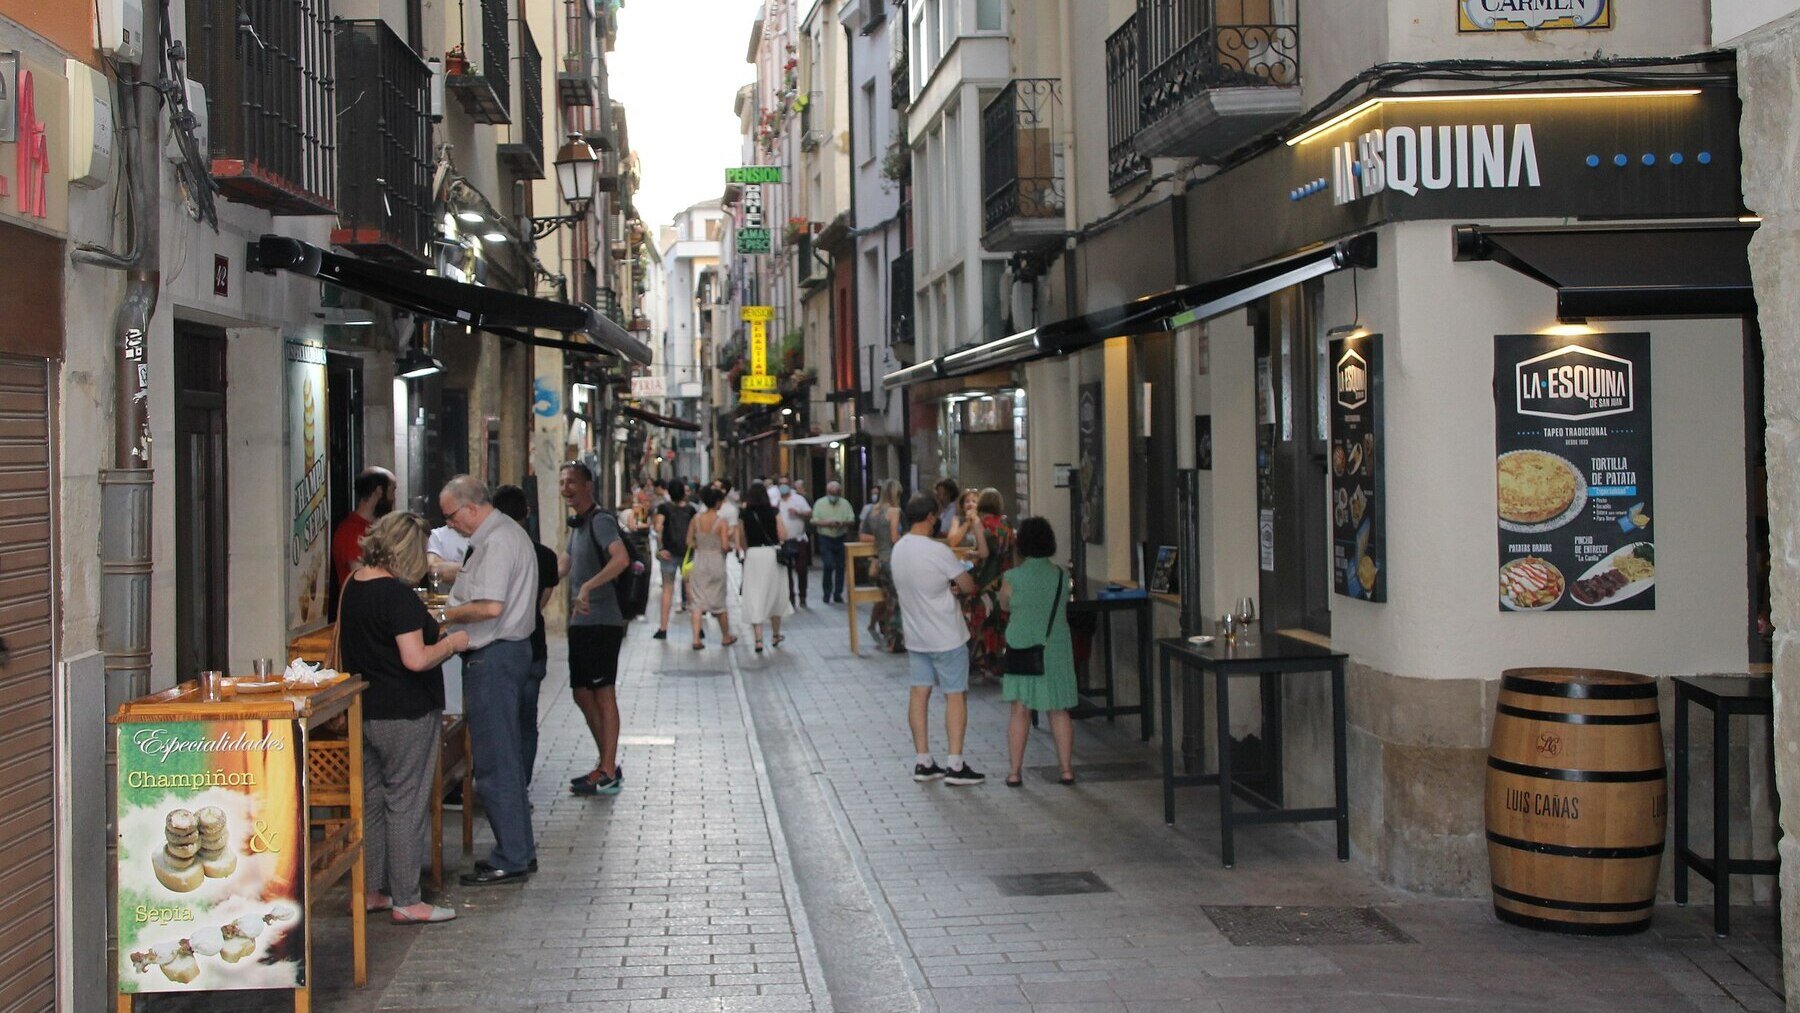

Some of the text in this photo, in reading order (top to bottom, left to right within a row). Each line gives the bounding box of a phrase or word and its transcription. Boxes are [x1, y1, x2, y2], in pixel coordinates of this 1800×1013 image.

[1358, 123, 1541, 197] ESQUINA
[727, 167, 781, 183] PENSION
[1523, 365, 1626, 401] LA ESQUINA
[1589, 397, 1623, 409] DE SAN JUAN
[1543, 427, 1608, 438] TAPEO TRADICIONAL
[1591, 456, 1628, 471] TORTILLA
[1592, 471, 1636, 486] DE PATATA
[1508, 544, 1552, 553] PATATAS BRAVAS
[1575, 545, 1582, 554] DE
[133, 729, 285, 763] Especialidades
[128, 768, 257, 790] Champiñon
[1506, 788, 1579, 820] LUIS CAÑAS
[249, 820, 281, 853] &
[135, 906, 195, 926] Sepia
